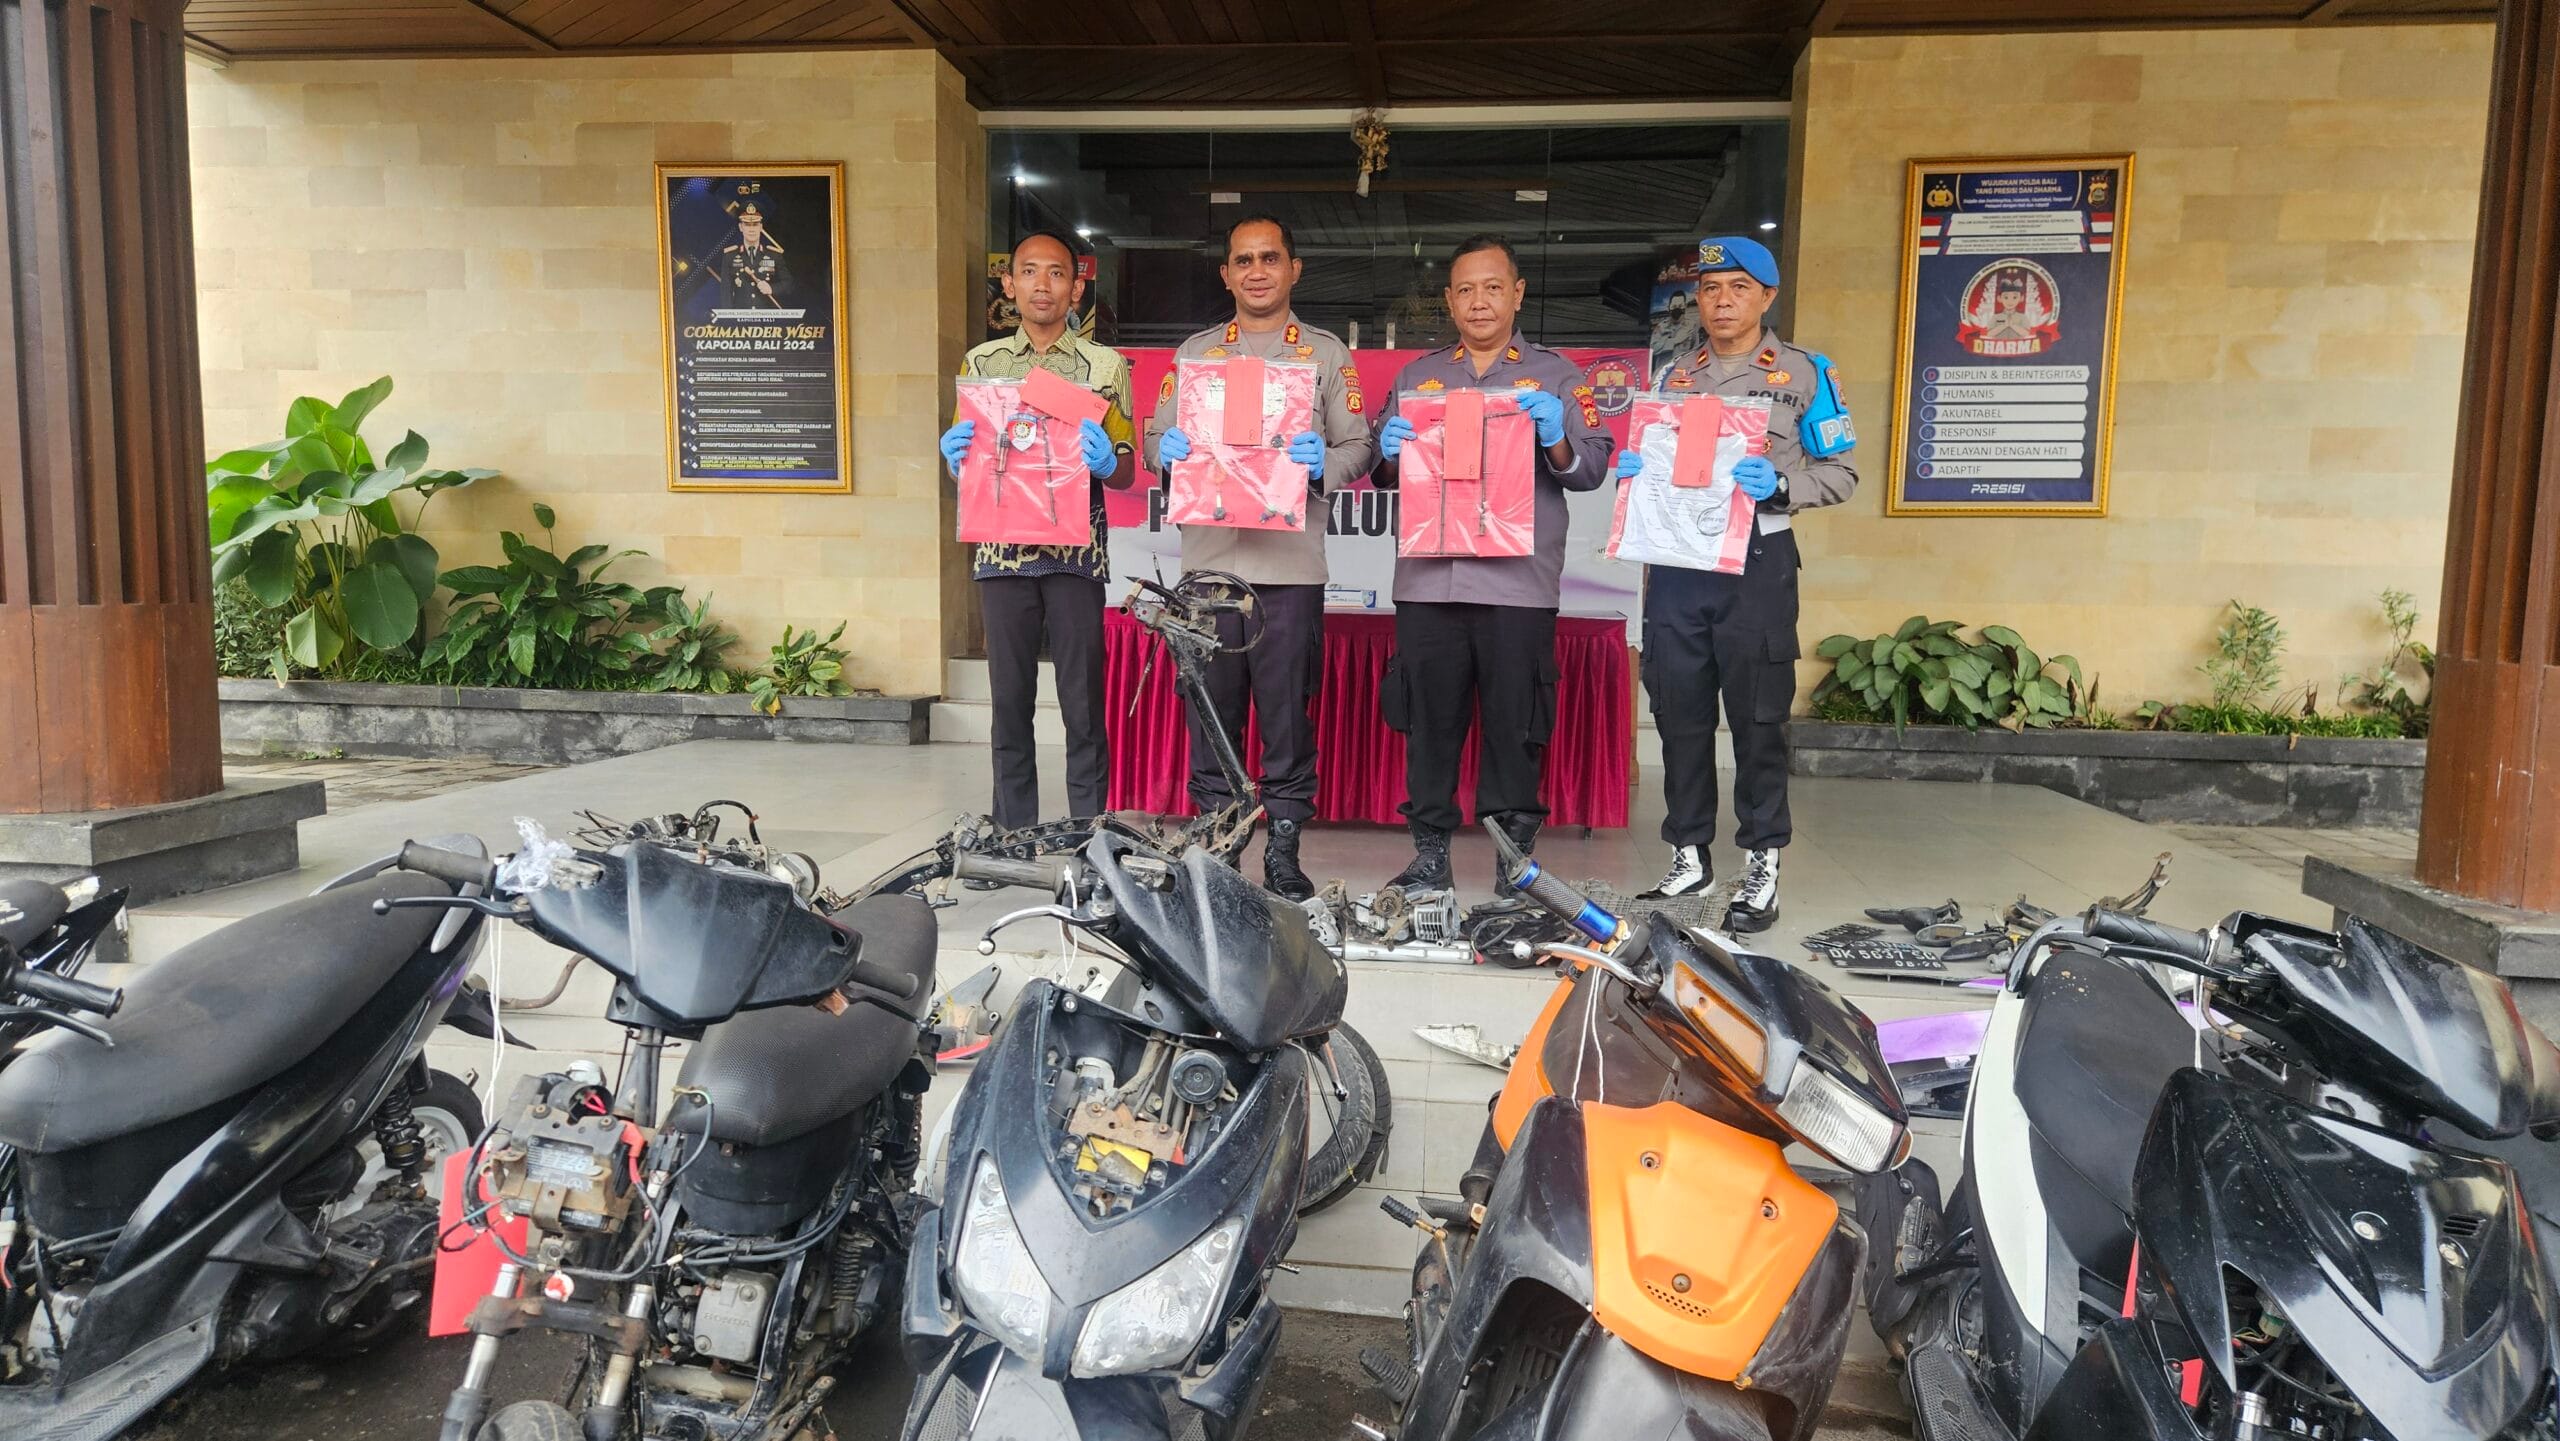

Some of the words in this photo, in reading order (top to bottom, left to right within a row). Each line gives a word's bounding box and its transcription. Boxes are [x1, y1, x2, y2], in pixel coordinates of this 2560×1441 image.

[2042, 177, 2057, 185] BALI
[2034, 186, 2062, 194] DHARMA
[684, 326, 783, 339] COMMANDER
[785, 323, 826, 340] WISH
[696, 340, 751, 350] KAPOLDA
[754, 340, 780, 350] BALI
[783, 340, 815, 350] 2024
[1973, 338, 2041, 355] DHARMA
[1944, 370, 1988, 380] DISIPLIN
[1990, 370, 1999, 379] &
[2001, 369, 2083, 380] BERINTEGRITAS
[1943, 389, 1995, 399] HUMANIS
[1941, 409, 2003, 418] AKUNTABEL
[1940, 427, 1997, 437] RESPONSIF
[1939, 446, 1992, 456] MELAYANI
[1995, 446, 2041, 456] DENGAN
[2043, 446, 2068, 456] HATI
[1937, 465, 1982, 475] ADAPTIF
[1970, 484, 2026, 494] PRESISI
[1828, 948, 1856, 959] DK
[1858, 949, 1905, 960] 5637
